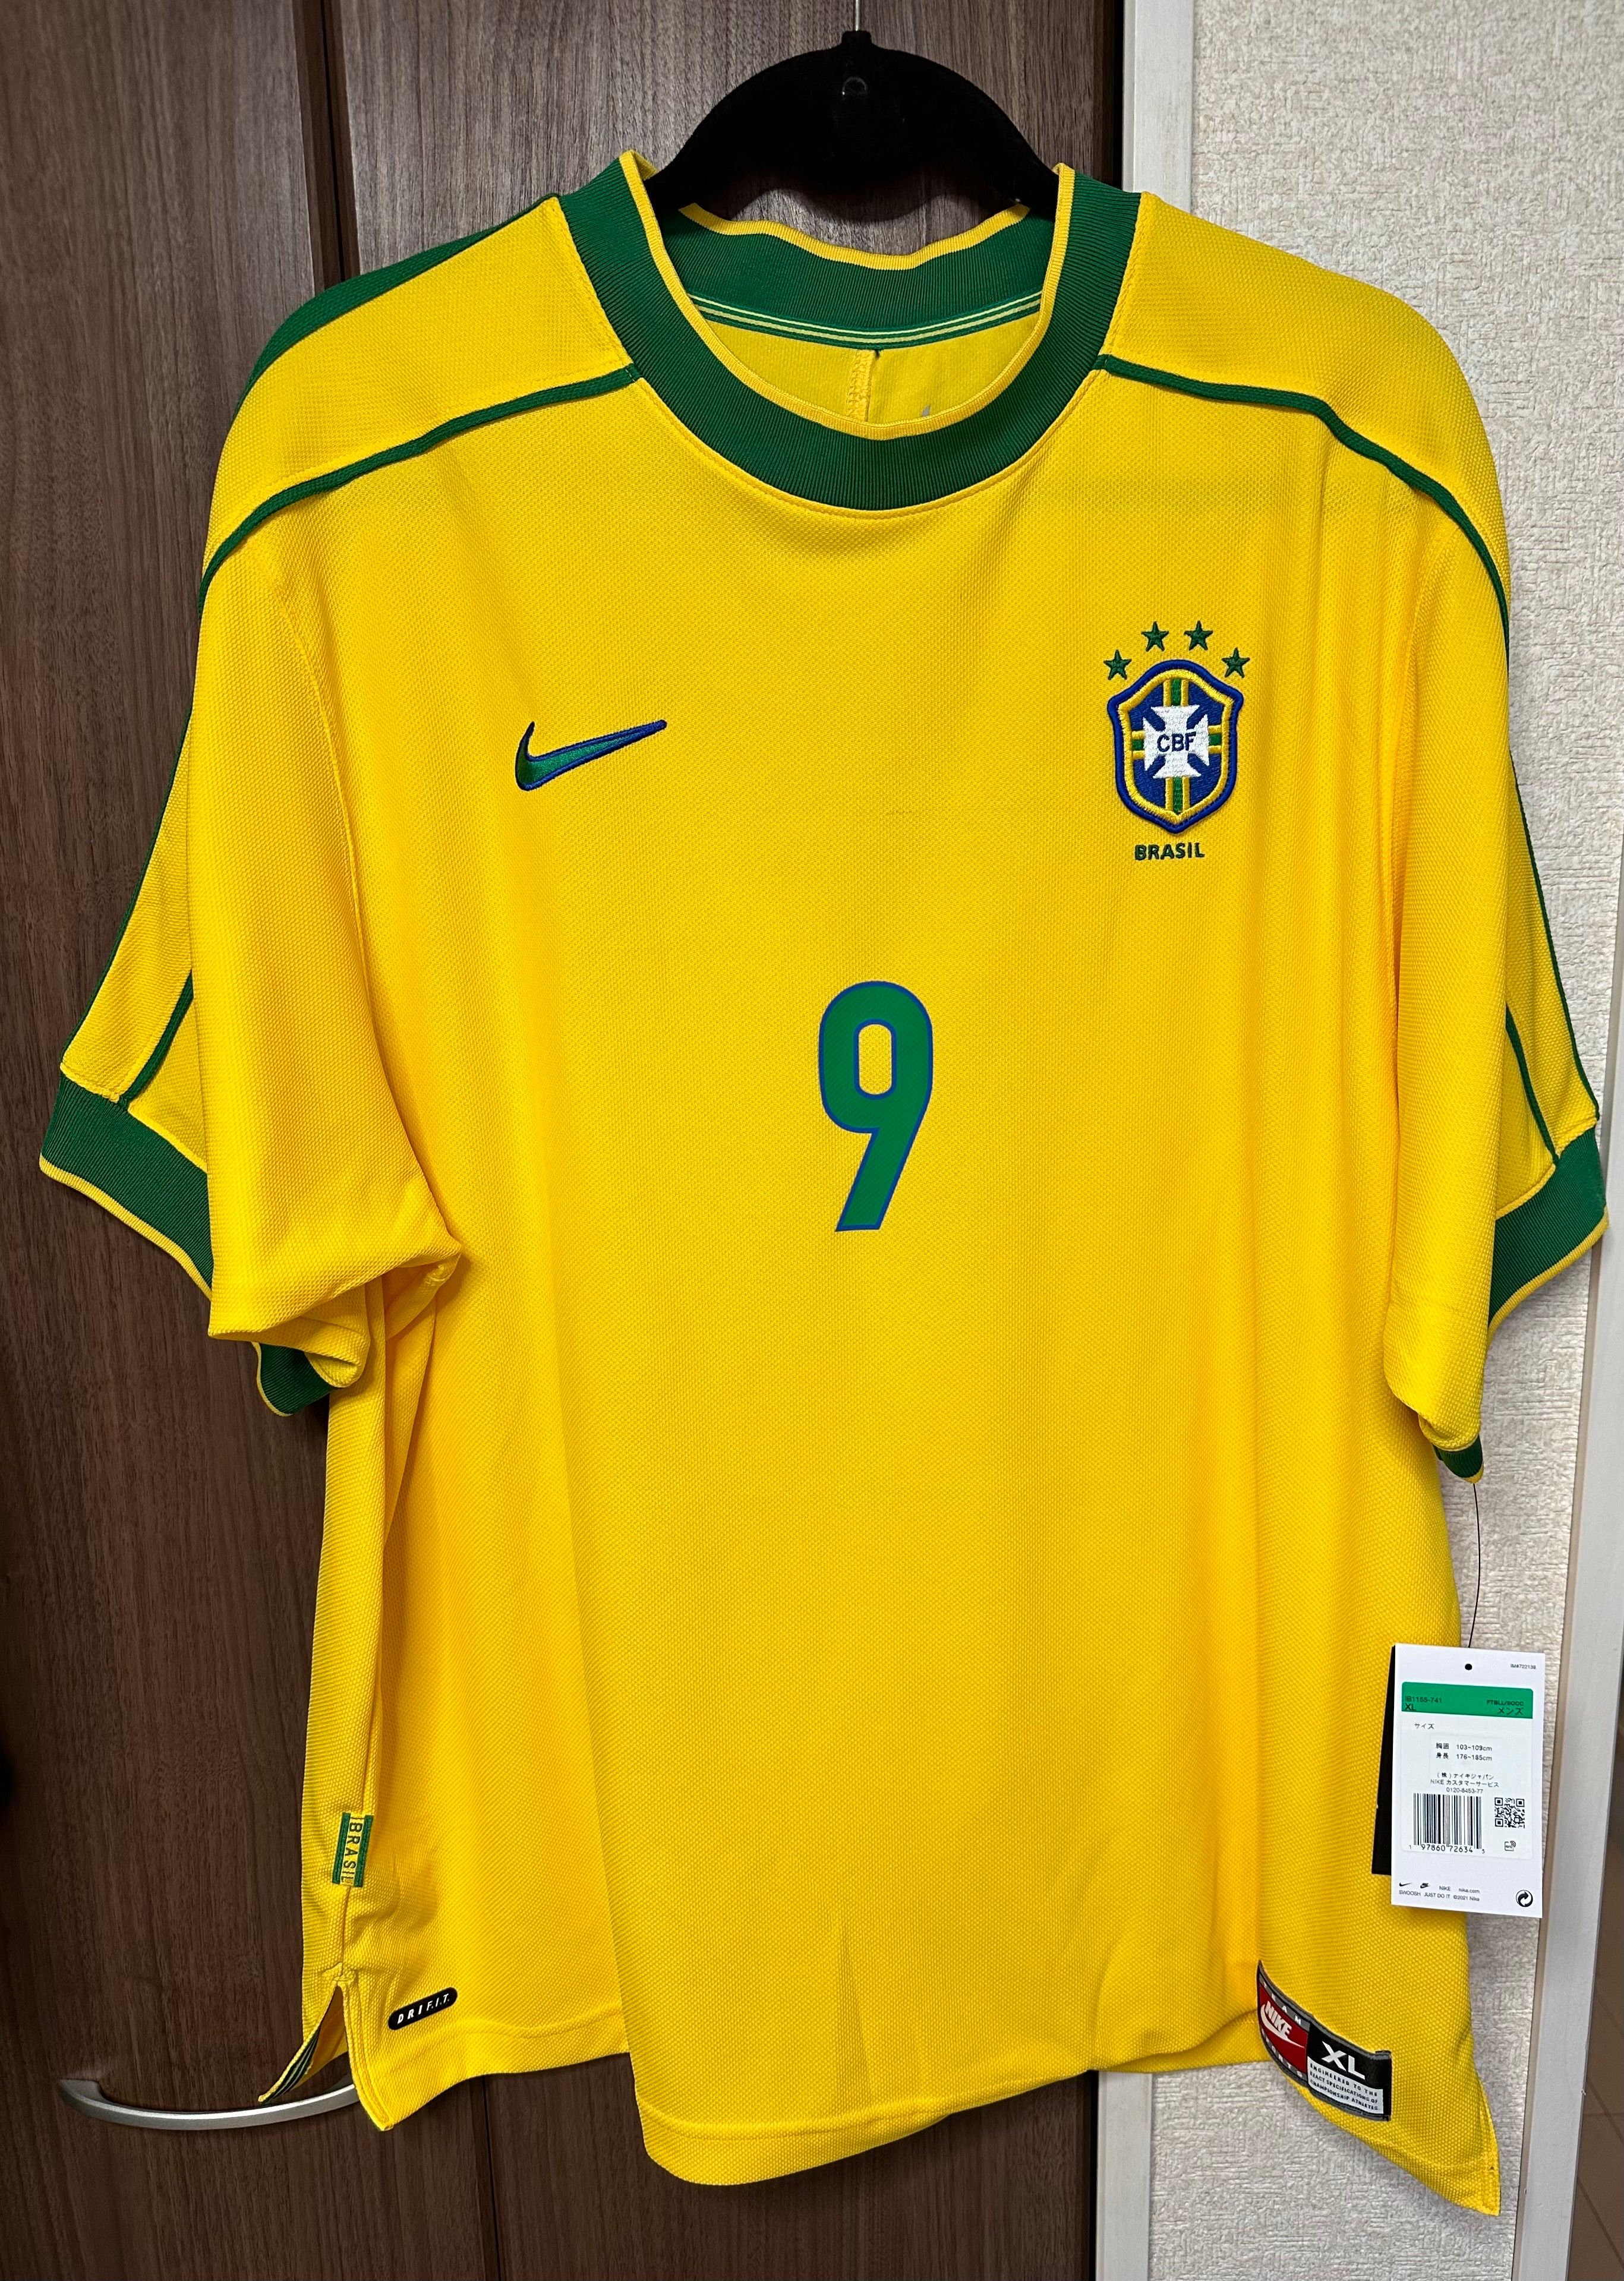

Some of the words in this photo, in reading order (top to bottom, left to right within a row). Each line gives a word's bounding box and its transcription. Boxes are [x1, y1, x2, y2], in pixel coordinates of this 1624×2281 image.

[1156, 731, 1197, 753] CBF
[1134, 842, 1205, 861] BRASIL
[818, 980, 934, 1232] 9
[1405, 1703, 1417, 1712] XL
[1497, 1707, 1524, 1715] メンズ
[1446, 1779, 1500, 1788] カスタマーサービス
[340, 1822, 363, 1883] BRASIL
[1449, 1845, 1473, 1853] 72634
[1265, 2000, 1292, 2035] NIKE
[1321, 2040, 1366, 2080] XL
[1310, 2062, 1349, 2086] ENGINEERED
[1364, 2088, 1377, 2097] THE
[1310, 2071, 1325, 2083] EXACT
[1326, 2078, 1370, 2101] SPECIFICATIONS
